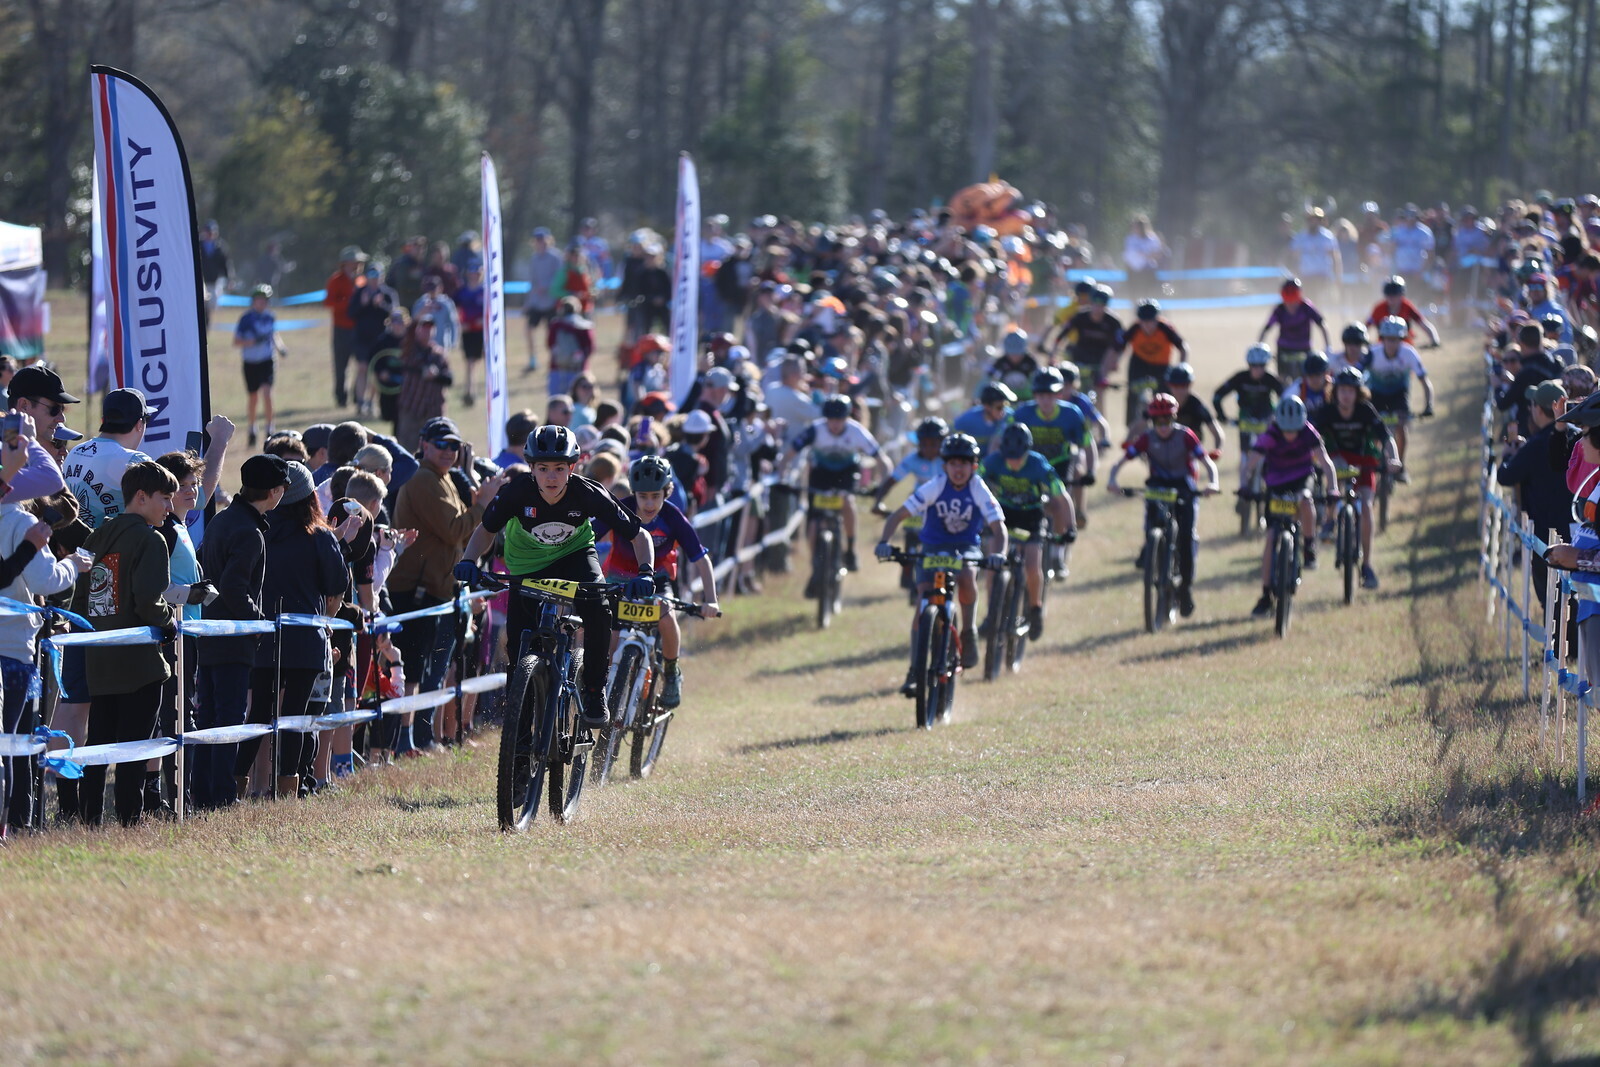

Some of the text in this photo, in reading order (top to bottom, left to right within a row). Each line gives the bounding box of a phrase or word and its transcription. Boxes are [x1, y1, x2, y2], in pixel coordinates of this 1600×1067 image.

[127, 136, 171, 442] INCLUSIVITY
[61, 464, 119, 515] AH RAGE
[623, 604, 654, 617] 2076
